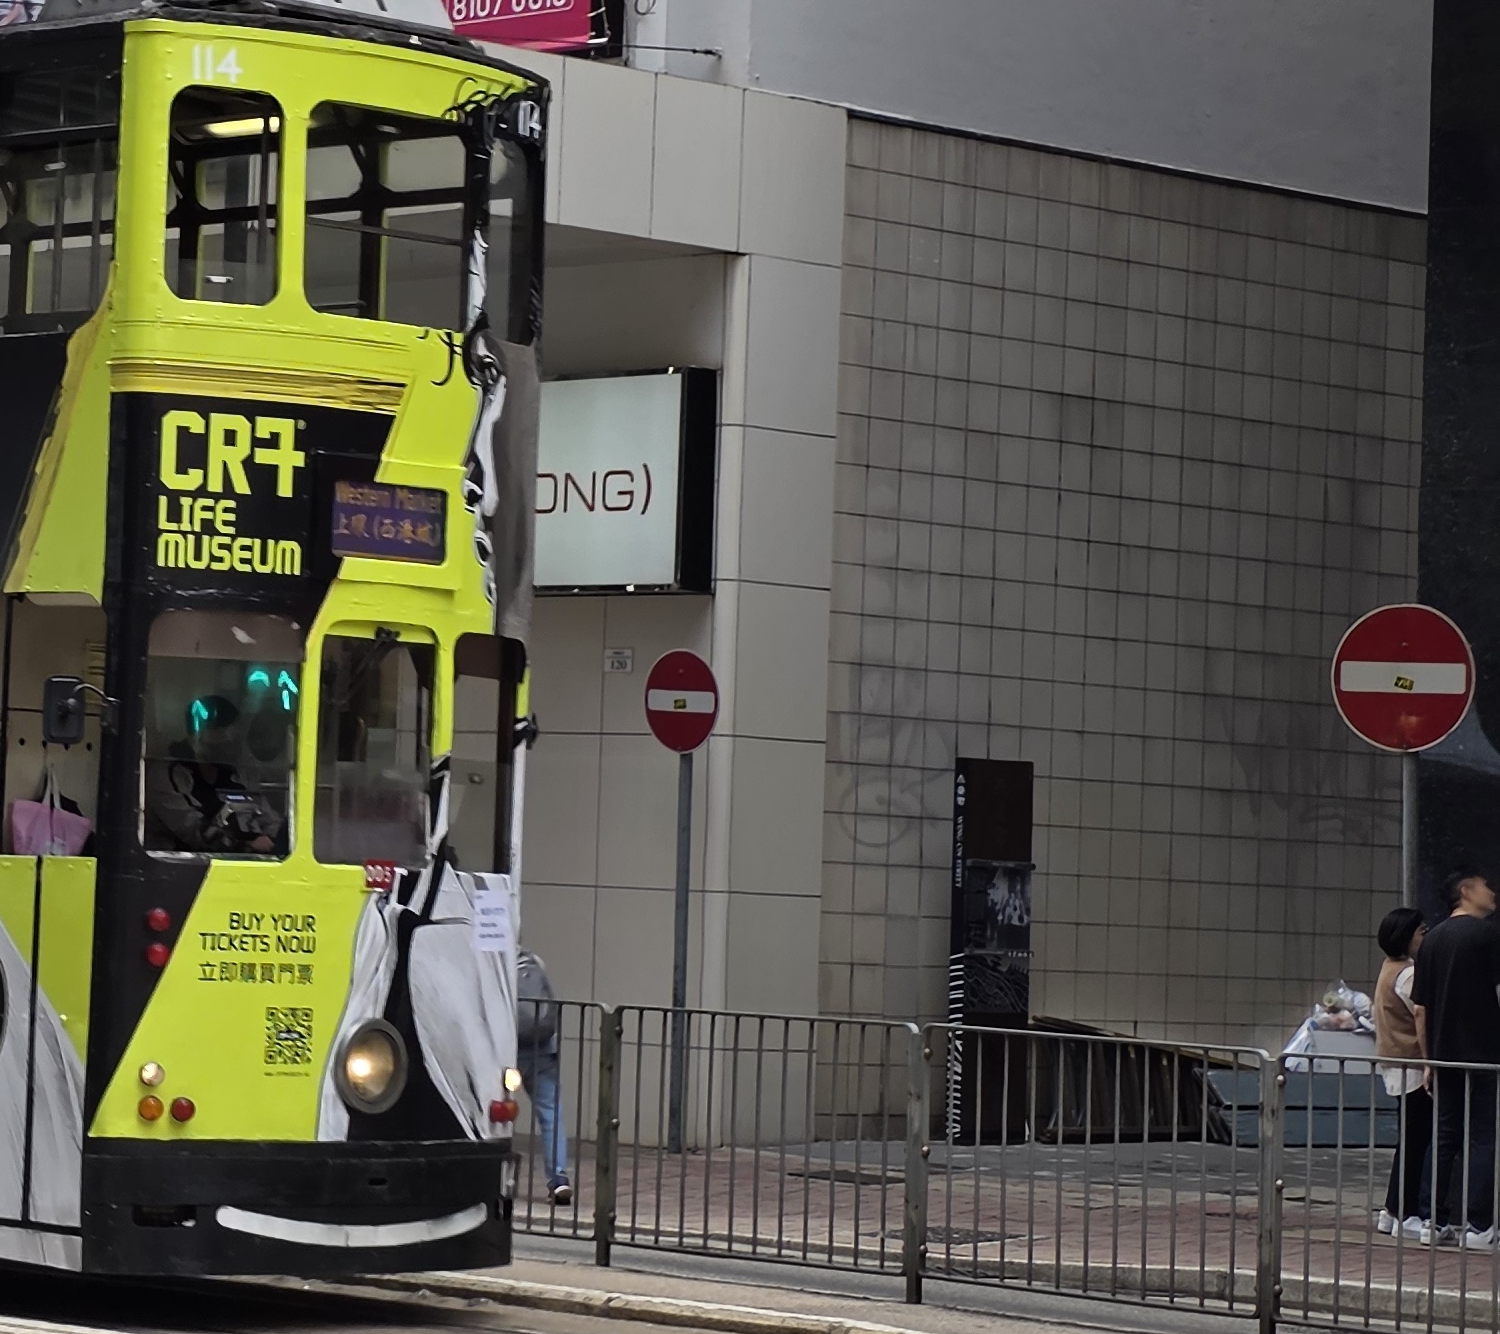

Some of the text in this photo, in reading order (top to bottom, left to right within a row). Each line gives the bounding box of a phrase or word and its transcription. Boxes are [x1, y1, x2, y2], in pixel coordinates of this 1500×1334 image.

[191, 45, 243, 84] 114
[158, 495, 237, 534] LIFE
[157, 532, 302, 576] MUSEUM
[229, 912, 316, 933] BUY YOUR
[198, 932, 316, 954] TICKETS NOW
